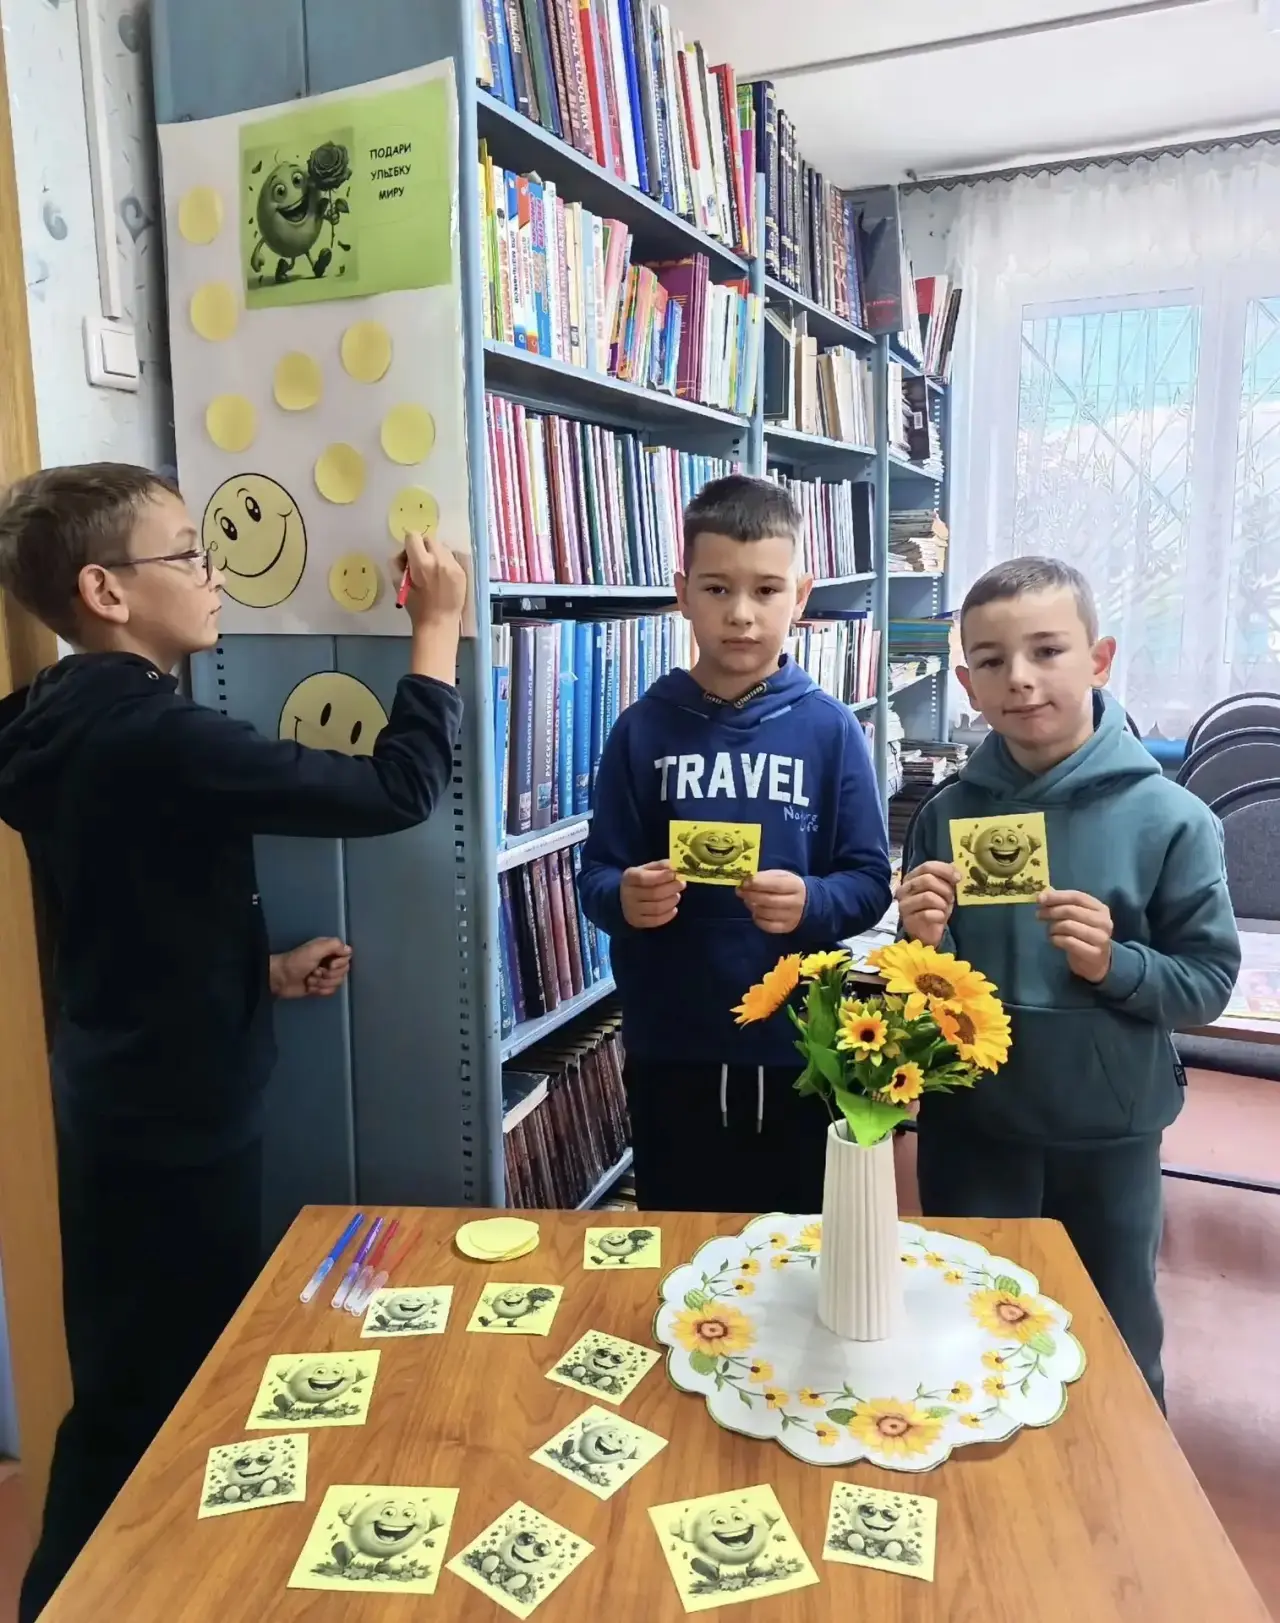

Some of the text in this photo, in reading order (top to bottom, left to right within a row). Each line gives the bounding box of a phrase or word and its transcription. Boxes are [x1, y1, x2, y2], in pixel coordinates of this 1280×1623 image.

[369, 142, 412, 160] ПОДАРИ
[370, 164, 412, 181] УЛЫБКУ
[378, 186, 405, 201] МИРУ
[544, 658, 554, 777] РУССКАЯ ЛИТЕРАТУРА
[654, 752, 810, 807] TRAVEL
